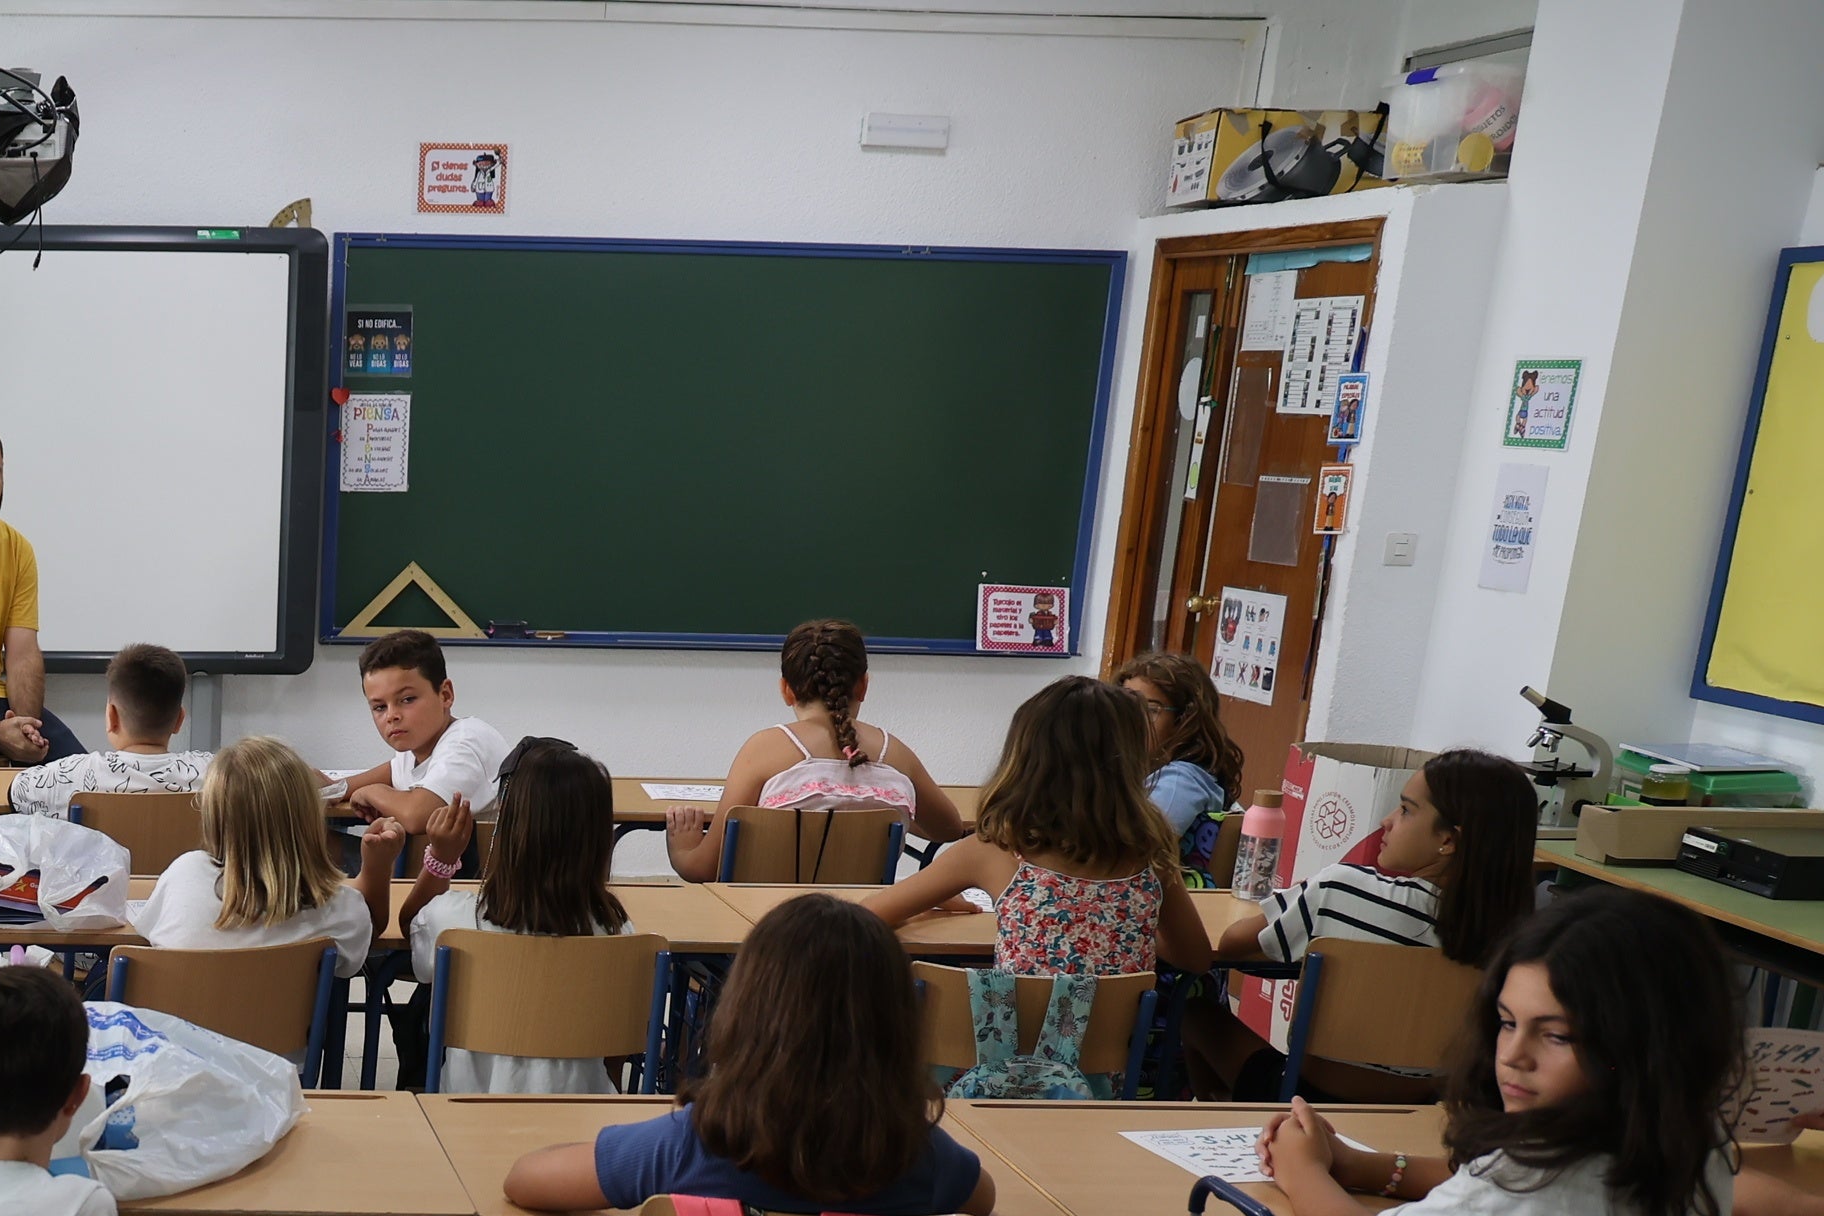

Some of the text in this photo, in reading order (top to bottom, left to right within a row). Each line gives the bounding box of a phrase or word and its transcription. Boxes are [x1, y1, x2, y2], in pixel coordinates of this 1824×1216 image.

[436, 172, 462, 182] dudas
[427, 184, 469, 193] pregunta.
[358, 319, 364, 328] SI
[365, 319, 373, 328] NO
[1544, 392, 1560, 401] una
[353, 407, 400, 420] PIENSA
[1534, 406, 1564, 418] actitud
